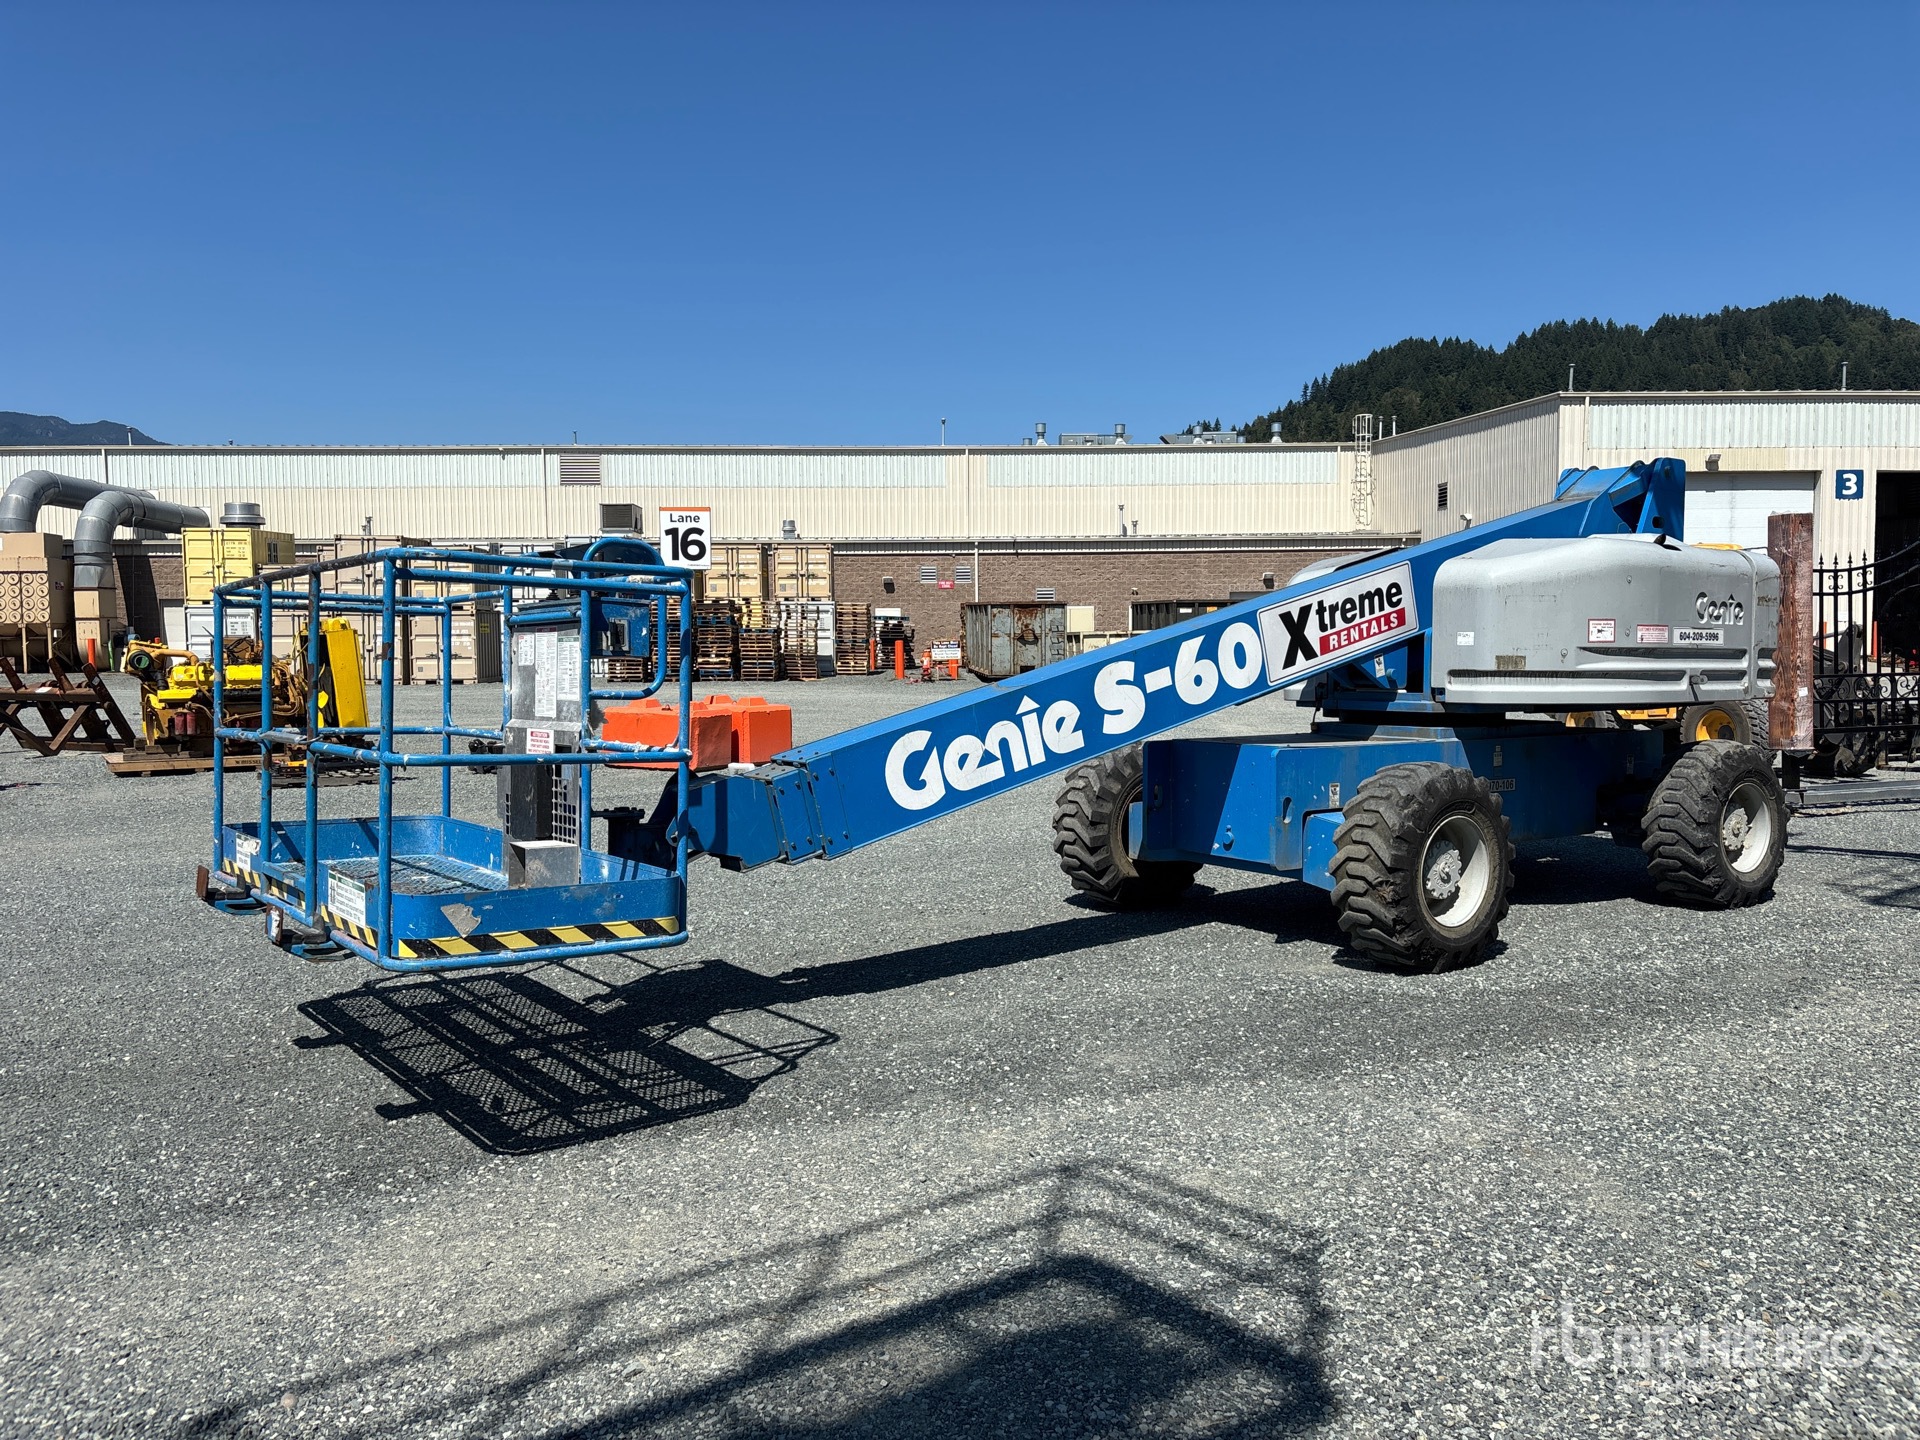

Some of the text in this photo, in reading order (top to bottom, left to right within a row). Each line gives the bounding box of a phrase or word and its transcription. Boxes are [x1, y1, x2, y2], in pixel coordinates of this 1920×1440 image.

[1842, 473, 1858, 495] 3
[669, 513, 701, 523] Lane
[664, 527, 707, 562] 16
[1695, 591, 1744, 625] Genie
[1278, 581, 1403, 671] Xtreme
[1329, 612, 1399, 651] RENTALS
[1679, 631, 1719, 641] 604-209-5996
[885, 622, 1263, 810] Genie S-60
[1490, 779, 1514, 791] 70-106
